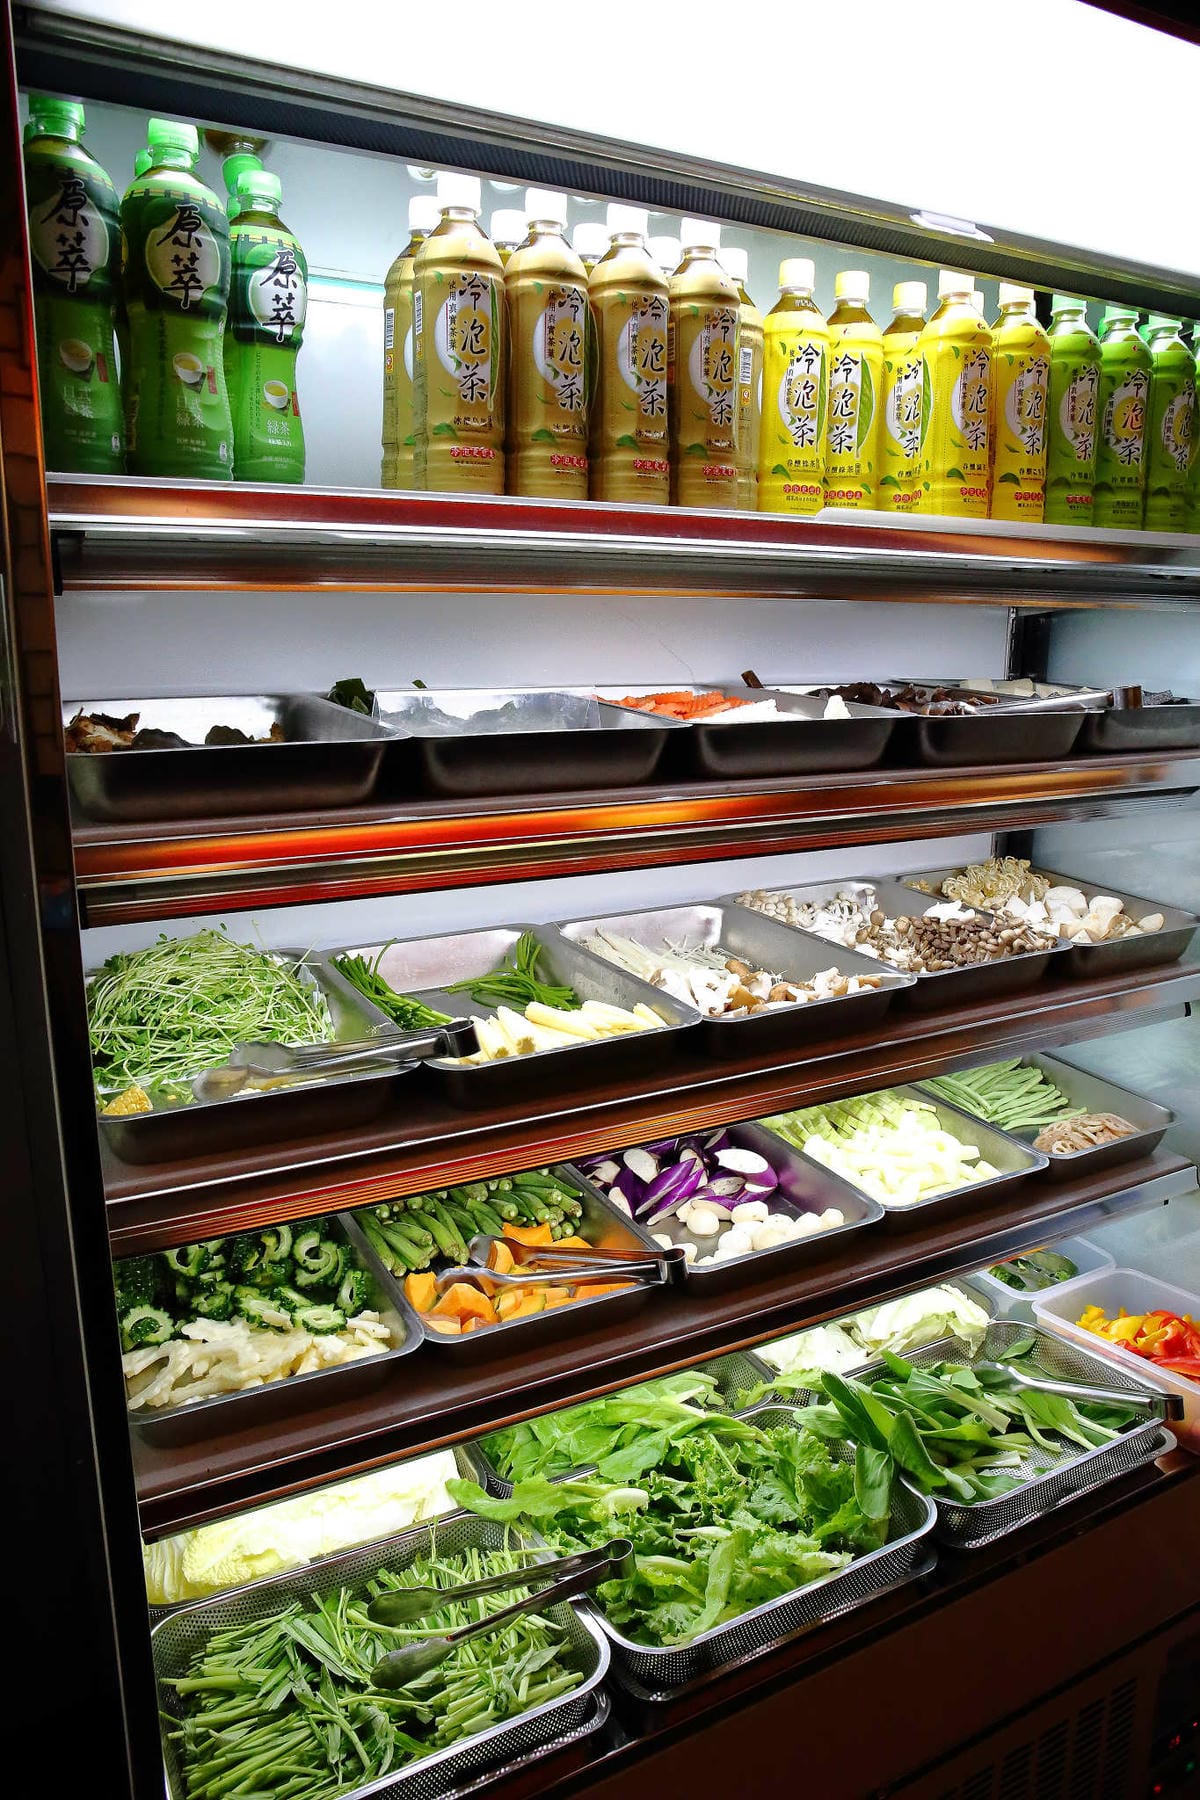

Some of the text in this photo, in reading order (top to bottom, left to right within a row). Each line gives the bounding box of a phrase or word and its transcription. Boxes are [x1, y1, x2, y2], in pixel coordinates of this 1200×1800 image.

[41, 181, 91, 293] 原萃
[156, 205, 203, 308] 原萃
[260, 251, 297, 341] 原萃
[459, 273, 489, 401] 冷泡茶
[558, 288, 584, 409] 冷泡茶
[640, 296, 667, 415] 冷泡茶
[711, 309, 736, 424] 冷泡茶
[792, 343, 820, 447] 冷泡茶
[969, 348, 989, 451] 冷泡茶
[832, 353, 859, 457] 冷泡茶
[1024, 357, 1047, 455] 冷泡茶
[1076, 365, 1098, 460] 冷泡茶
[1119, 370, 1147, 465] 冷泡茶
